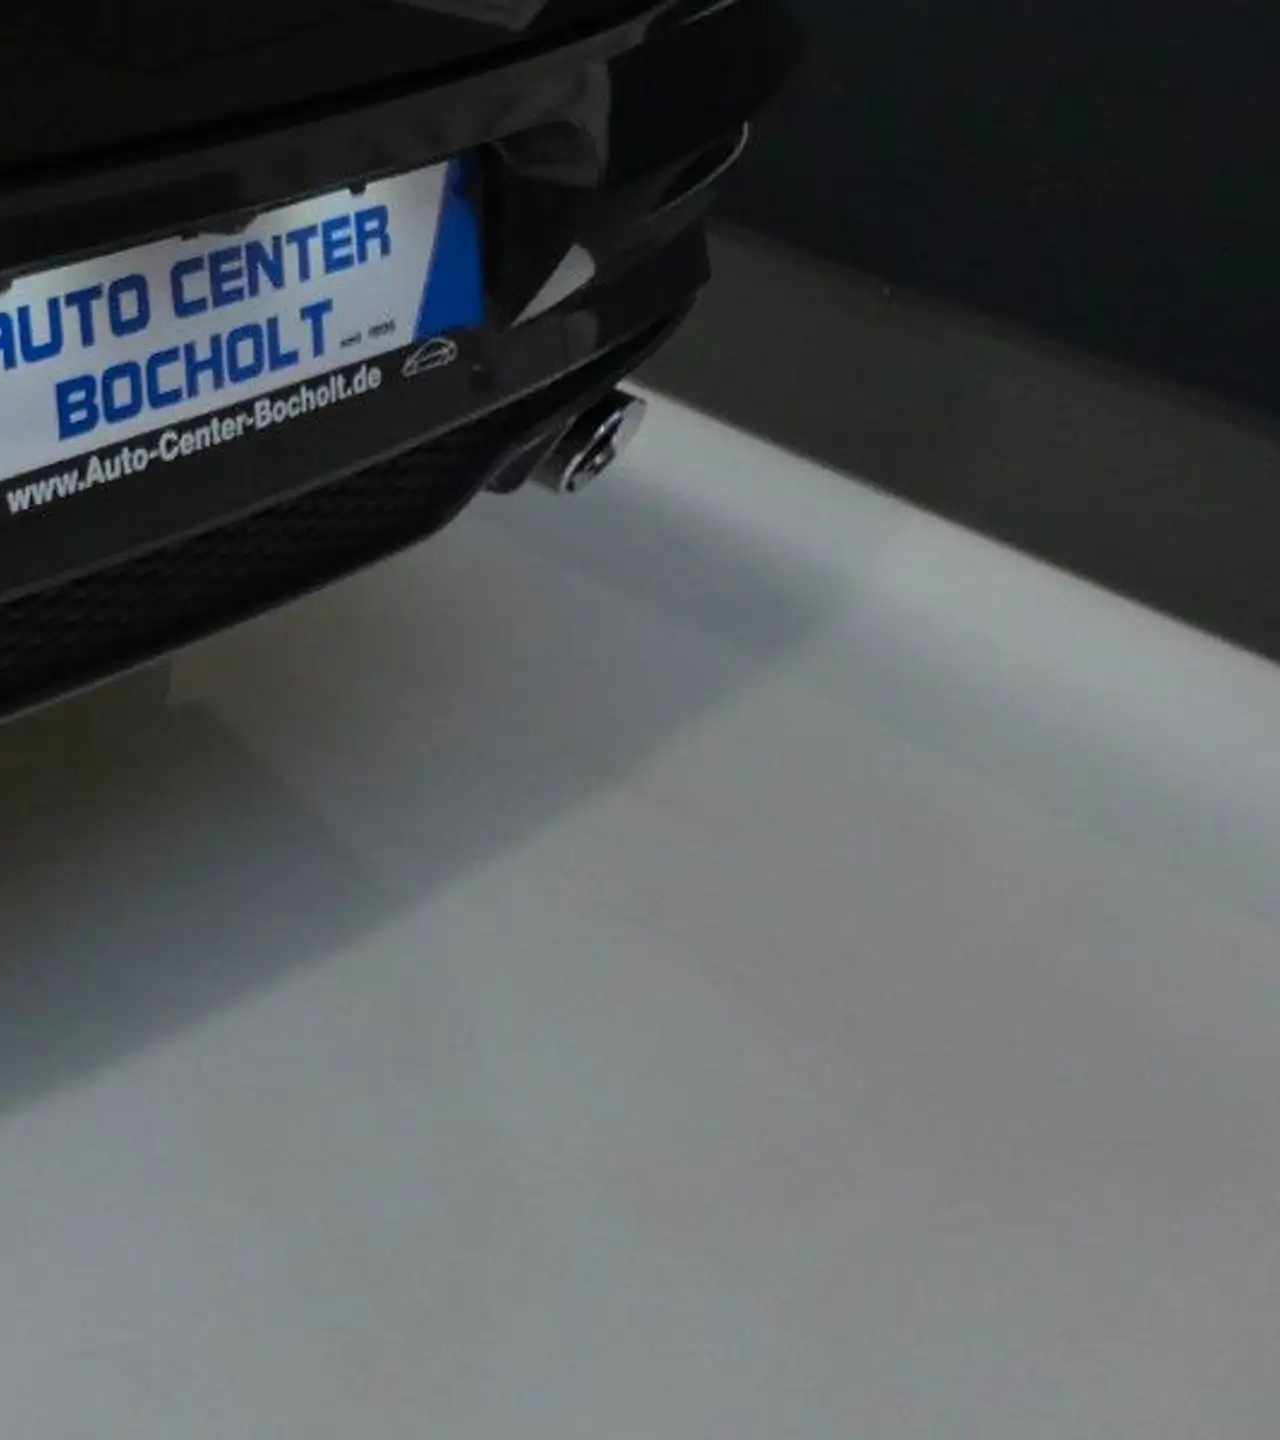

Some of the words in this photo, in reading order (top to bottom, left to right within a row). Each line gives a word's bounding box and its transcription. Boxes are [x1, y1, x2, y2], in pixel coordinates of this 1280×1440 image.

[169, 203, 396, 320] CENTER
[5, 365, 384, 515] www.Auto-Center-Bocholt.de
[51, 297, 335, 444] BOCHOLT
